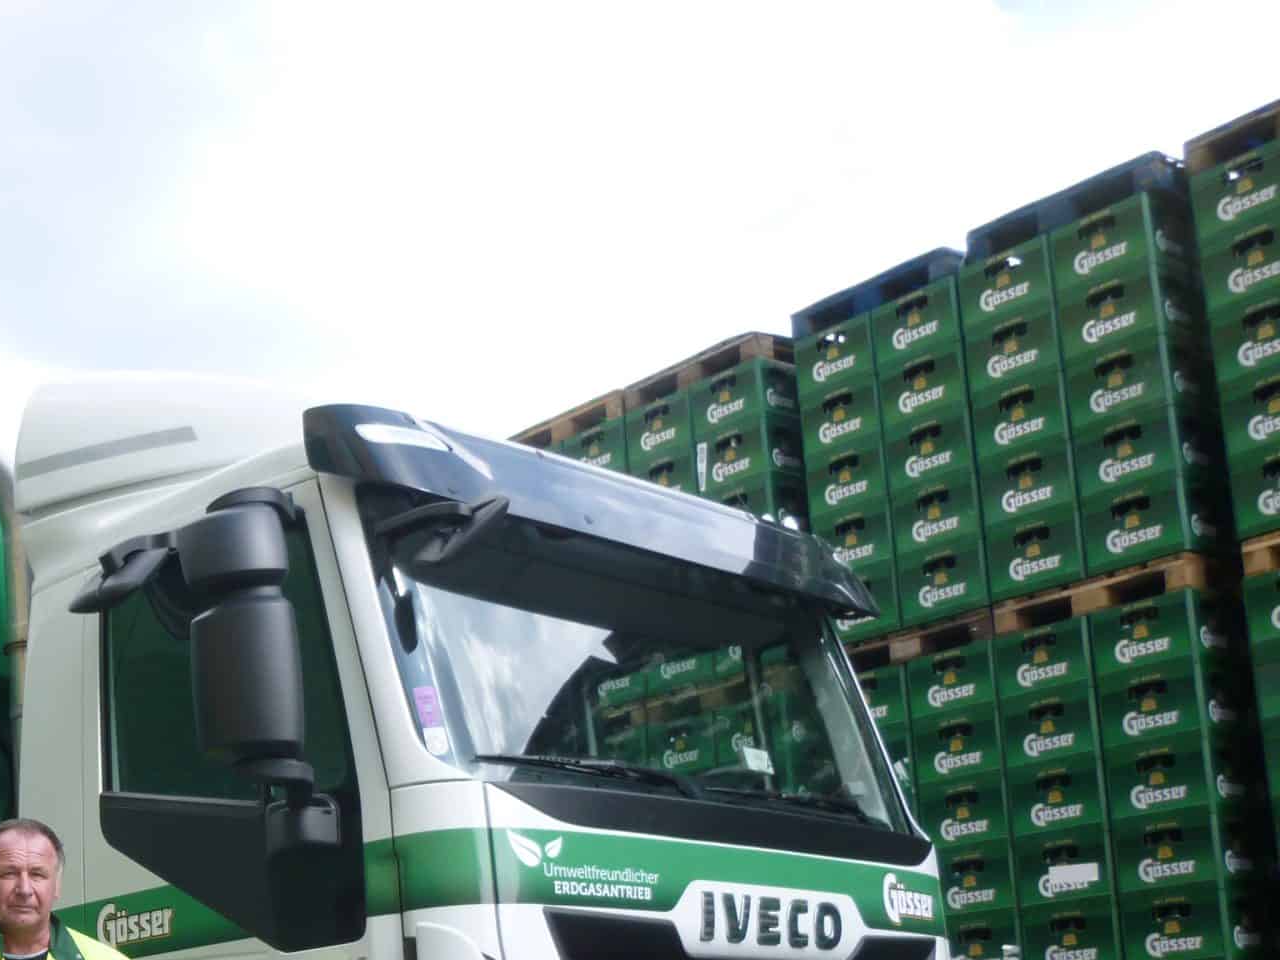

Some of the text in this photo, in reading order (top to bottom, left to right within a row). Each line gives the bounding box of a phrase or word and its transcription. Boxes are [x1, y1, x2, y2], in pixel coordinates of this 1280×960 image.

[1074, 241, 1127, 276] Gösser
[980, 280, 1029, 313] Gösser
[892, 318, 938, 351] Gösser
[1082, 311, 1136, 344] Gösser
[813, 353, 856, 383] Gösser
[987, 347, 1038, 379] Gösser
[707, 397, 744, 425] Gösser
[898, 384, 944, 415] Gösser
[1090, 382, 1144, 414] Gösser
[819, 416, 862, 445] Gösser
[994, 416, 1045, 446] Gösser
[905, 450, 952, 479] Gösser
[1099, 449, 1155, 484] Gösser
[825, 478, 868, 506] Gösser
[1002, 482, 1053, 514] Gösser
[912, 514, 960, 544] Gösser
[1106, 524, 1162, 555] Gösser
[1009, 554, 1061, 582] Gösser
[919, 580, 966, 609] Gösser
[1115, 636, 1170, 665] Gösser
[1017, 661, 1068, 688] Gösser
[928, 683, 975, 709] Gösser
[1123, 710, 1179, 737] Gösser
[1024, 732, 1074, 758] Gösser
[934, 747, 982, 775] Gösser
[1130, 784, 1187, 811] Gösser
[940, 815, 988, 842] Gösser
[1031, 802, 1083, 828] Gösser
[543, 862, 660, 885] Umweltfreundlicher
[1138, 857, 1195, 884] Gösser
[554, 880, 652, 900] ERDGASANTRIEB
[883, 872, 934, 926] Gösser
[947, 886, 996, 910] Gösser
[96, 902, 174, 948] Gösser
[699, 890, 842, 951] IVECO
[1145, 932, 1202, 959] Gösser
